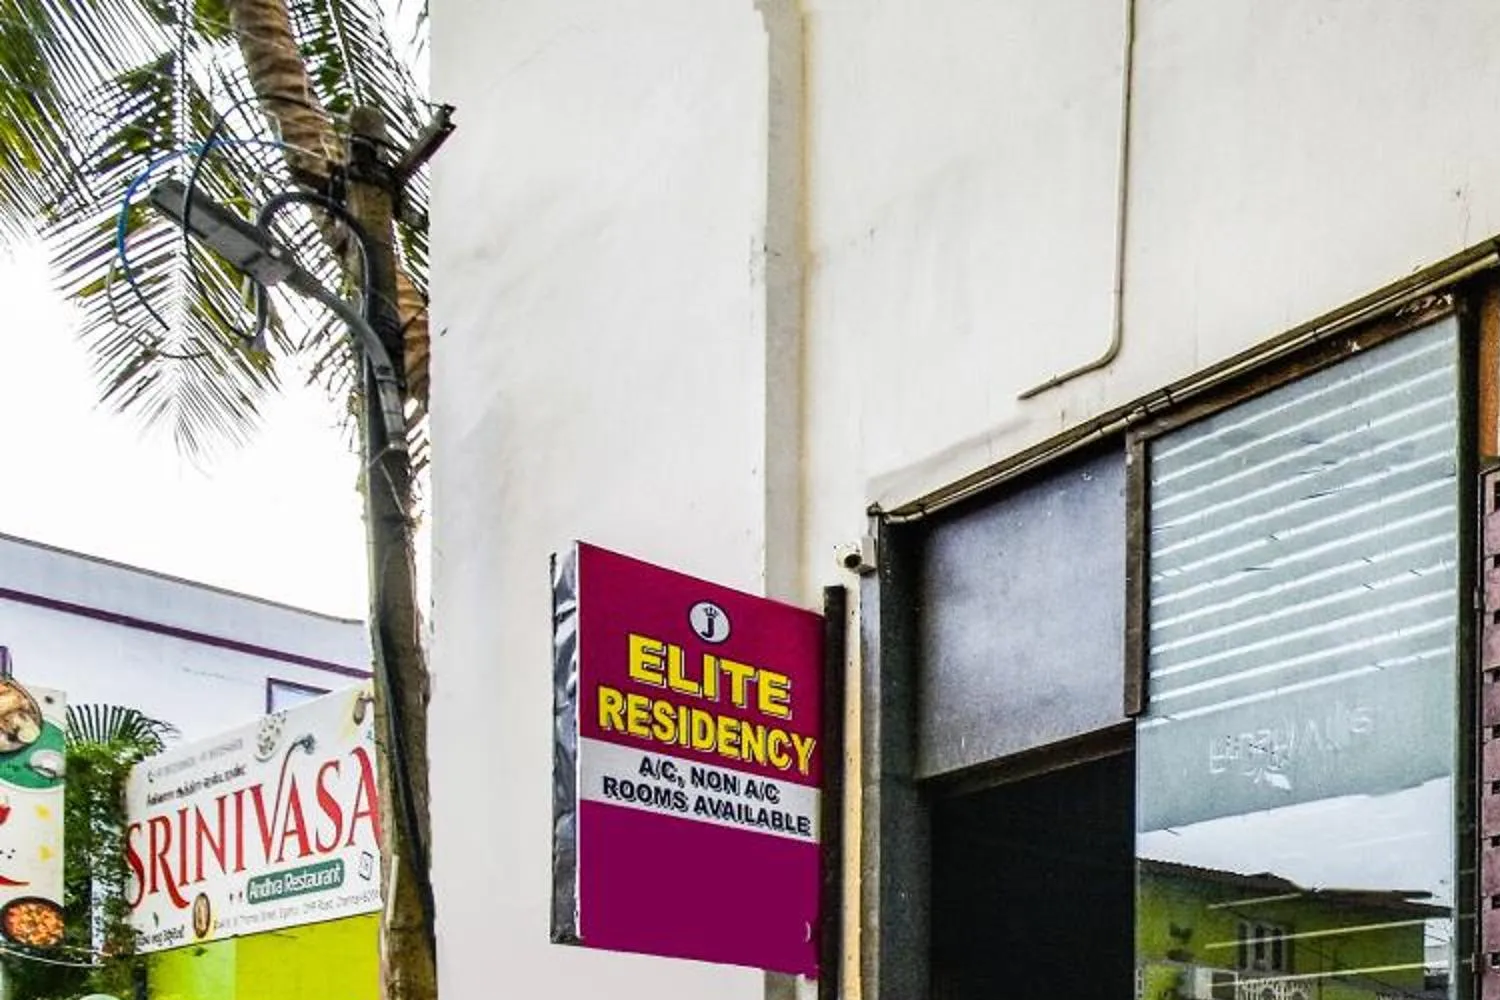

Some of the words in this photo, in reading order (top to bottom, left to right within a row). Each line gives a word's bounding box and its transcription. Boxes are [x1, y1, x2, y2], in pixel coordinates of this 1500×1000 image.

[629, 633, 792, 720] ELITE
[598, 685, 816, 775] RESIDENCY
[603, 776, 688, 812] ROOMS
[694, 796, 811, 836] AVAILABLE
[639, 757, 685, 788] A/C,
[691, 766, 740, 796] NON
[744, 780, 780, 804] A/C
[125, 745, 383, 909] SRINIVASA
[284, 863, 341, 892] Restaurant
